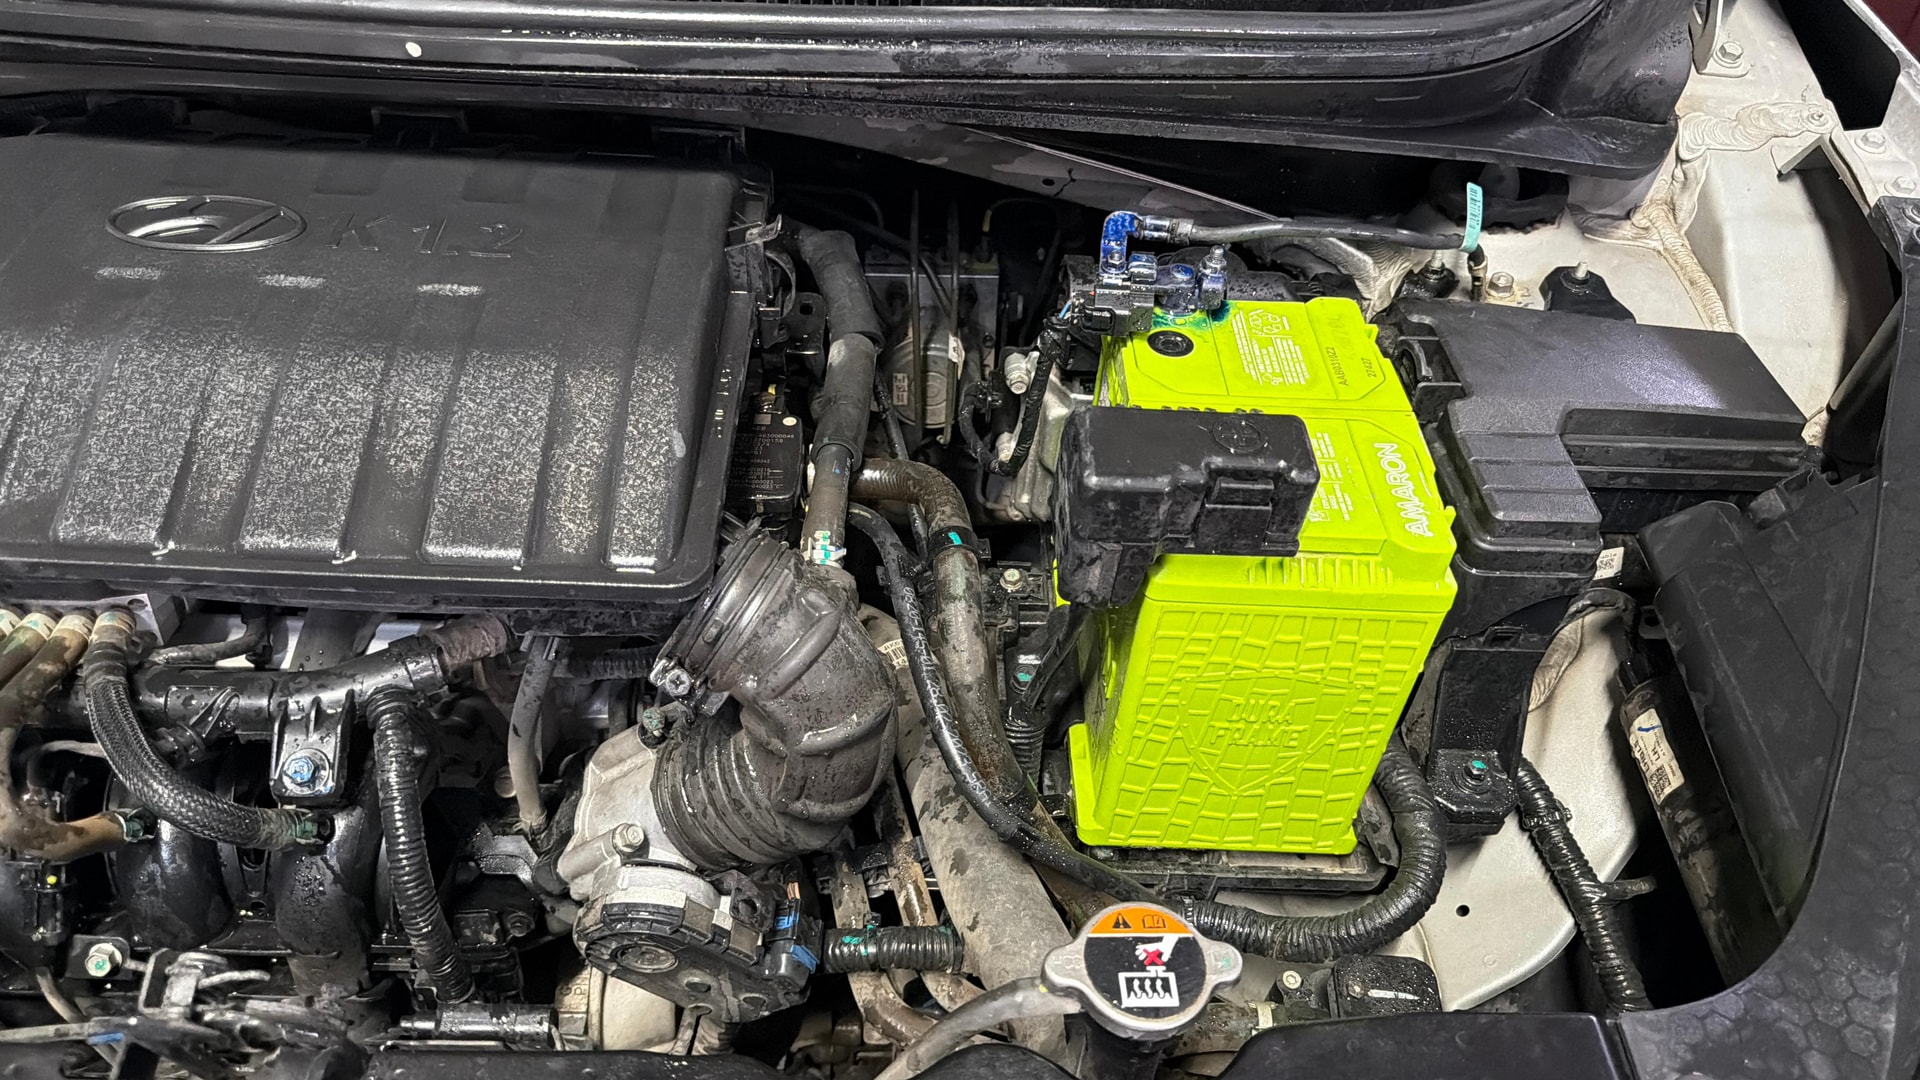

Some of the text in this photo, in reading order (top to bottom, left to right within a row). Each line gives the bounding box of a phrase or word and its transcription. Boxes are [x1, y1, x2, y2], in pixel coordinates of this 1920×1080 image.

[1373, 443, 1434, 537] AMARON
[1226, 699, 1294, 725] DURA
[1208, 721, 1310, 748] FRAME
